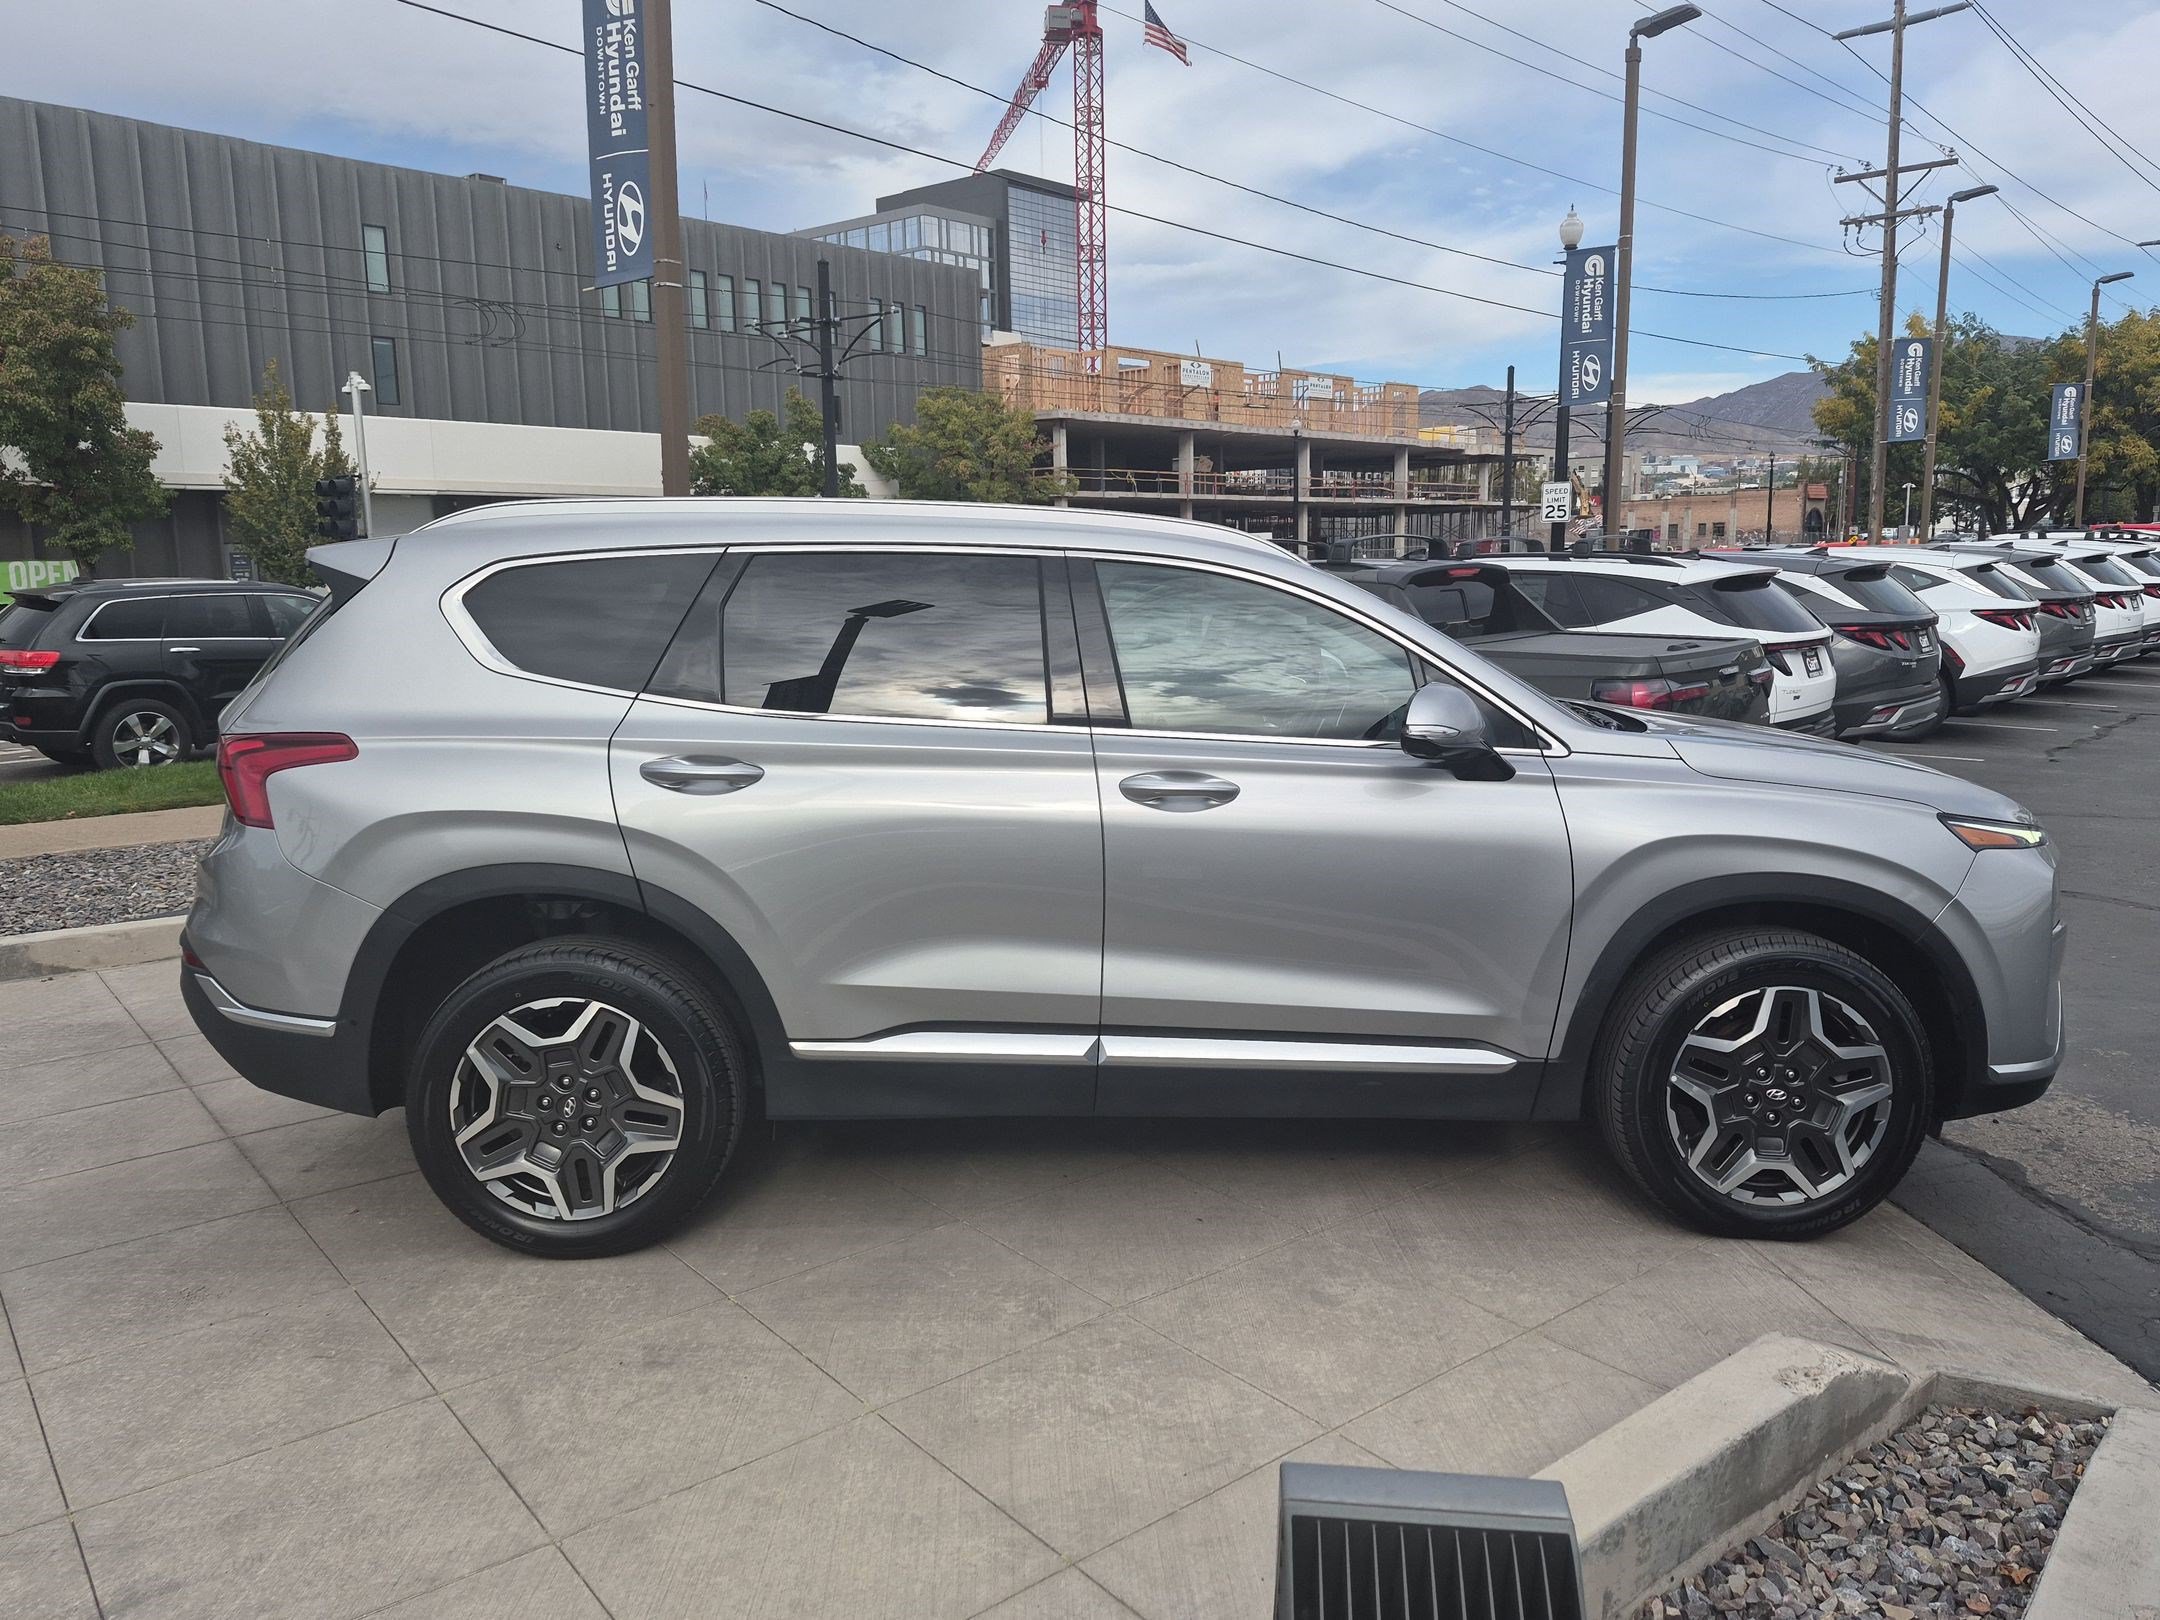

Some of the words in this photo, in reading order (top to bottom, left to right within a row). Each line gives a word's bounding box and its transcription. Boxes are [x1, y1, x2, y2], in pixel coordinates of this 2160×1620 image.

[623, 18, 637, 59] Ken
[596, 26, 606, 115] DOWNTOWN
[605, 21, 627, 137] Hyundai
[625, 61, 642, 111] Garff
[602, 173, 617, 272] HYUNDAI
[1595, 277, 1604, 296] Ken
[1581, 278, 1594, 333] Hyundai
[1594, 297, 1604, 321] Garff
[1571, 350, 1580, 399] HYUNDAI
[1904, 358, 1914, 394] Hyundai
[1895, 405, 1903, 437] HYUNDAI
[1544, 487, 1569, 495] SPEED
[1546, 496, 1566, 504] LIMIT
[1544, 504, 1567, 519] 25
[8, 560, 80, 590] OPEN
